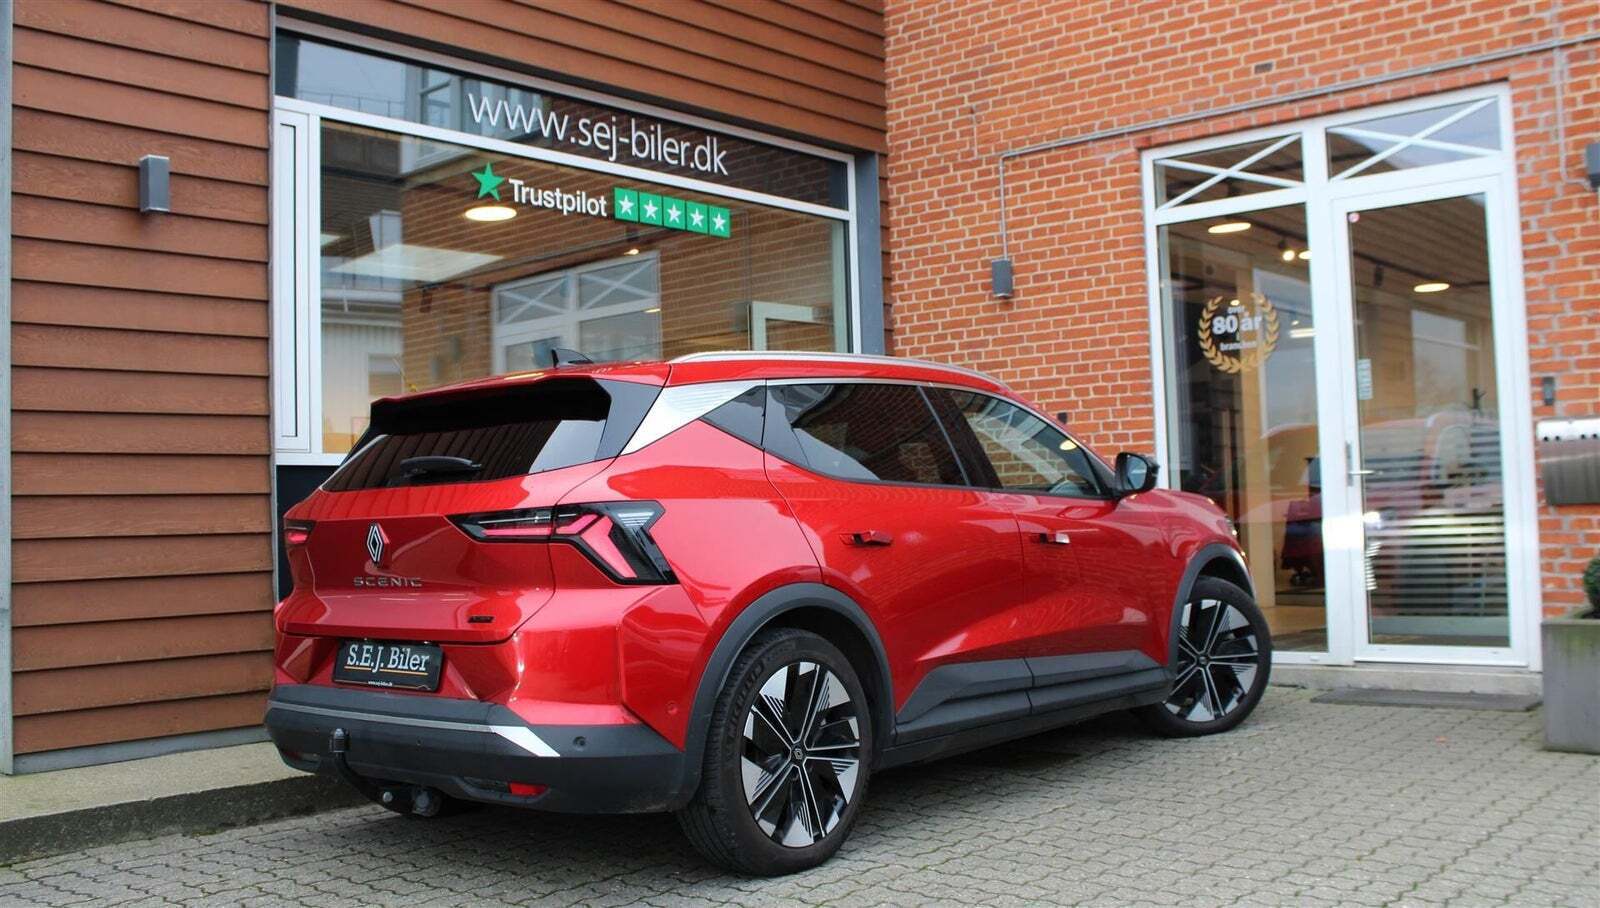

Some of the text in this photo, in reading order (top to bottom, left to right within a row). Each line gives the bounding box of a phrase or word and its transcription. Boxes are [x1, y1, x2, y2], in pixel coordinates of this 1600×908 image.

[467, 93, 729, 176] www.sej-biler.dk
[508, 177, 608, 217] Trustpilot
[1212, 311, 1262, 335] 80 år
[353, 576, 423, 588] SCENIC
[346, 644, 430, 673] S.E.J. Biler
